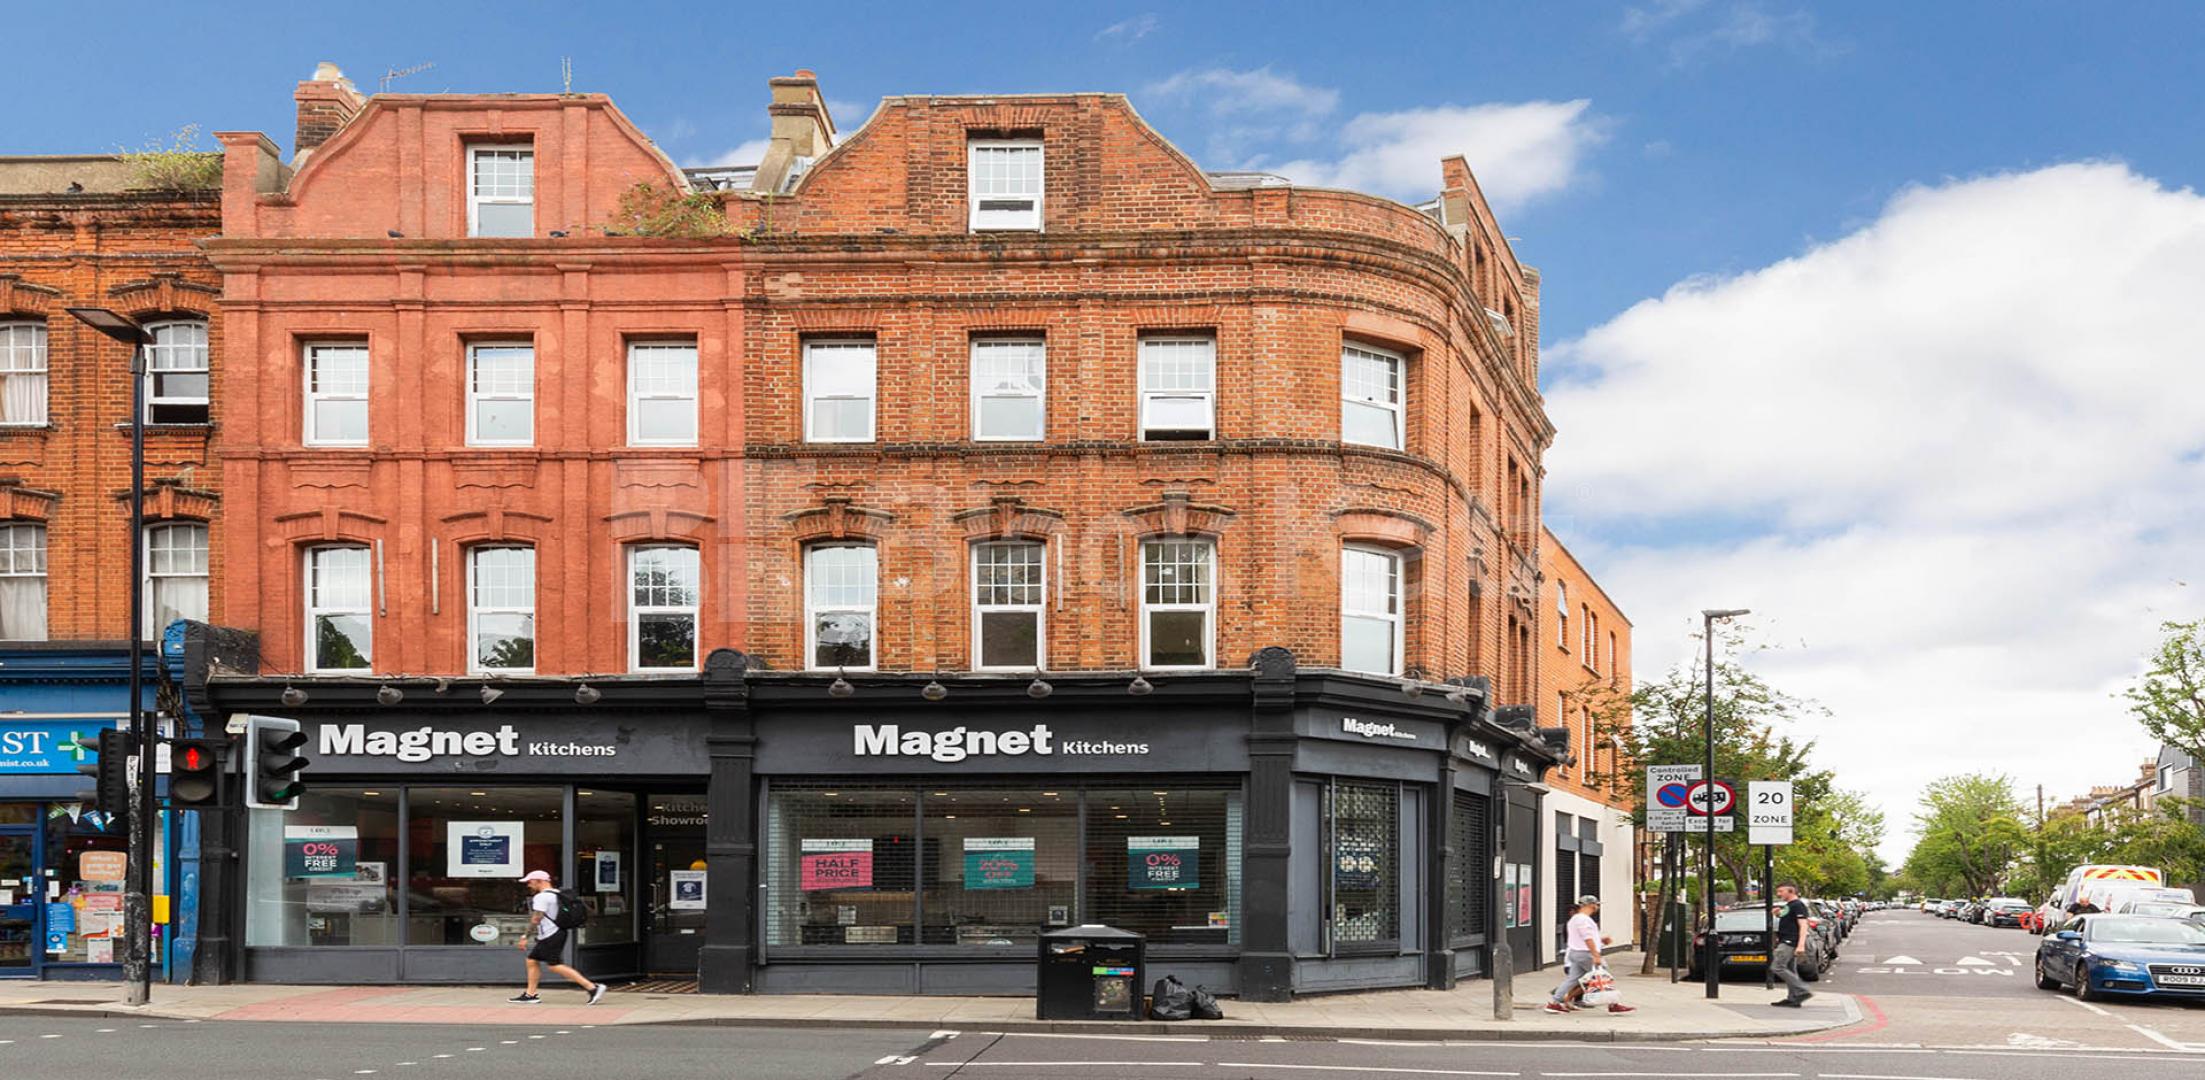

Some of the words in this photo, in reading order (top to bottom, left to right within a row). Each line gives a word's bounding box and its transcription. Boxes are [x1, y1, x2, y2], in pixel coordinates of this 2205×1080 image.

[1343, 717, 1396, 737] Magnet
[318, 723, 520, 763] Magnet
[528, 742, 617, 757] Kitchens
[853, 723, 1054, 763] Magnet
[1062, 740, 1150, 755] Kitchens
[1649, 766, 1699, 774] Controlled
[1757, 791, 1785, 805] 20
[1753, 815, 1789, 824] ZONE
[303, 843, 339, 856] 0%
[304, 860, 338, 868] FREE
[815, 858, 860, 868] HALF
[1145, 853, 1182, 866] 0%
[815, 868, 860, 878] PRICE
[1147, 870, 1181, 879] FREE
[1855, 967, 2015, 977] SLOW
